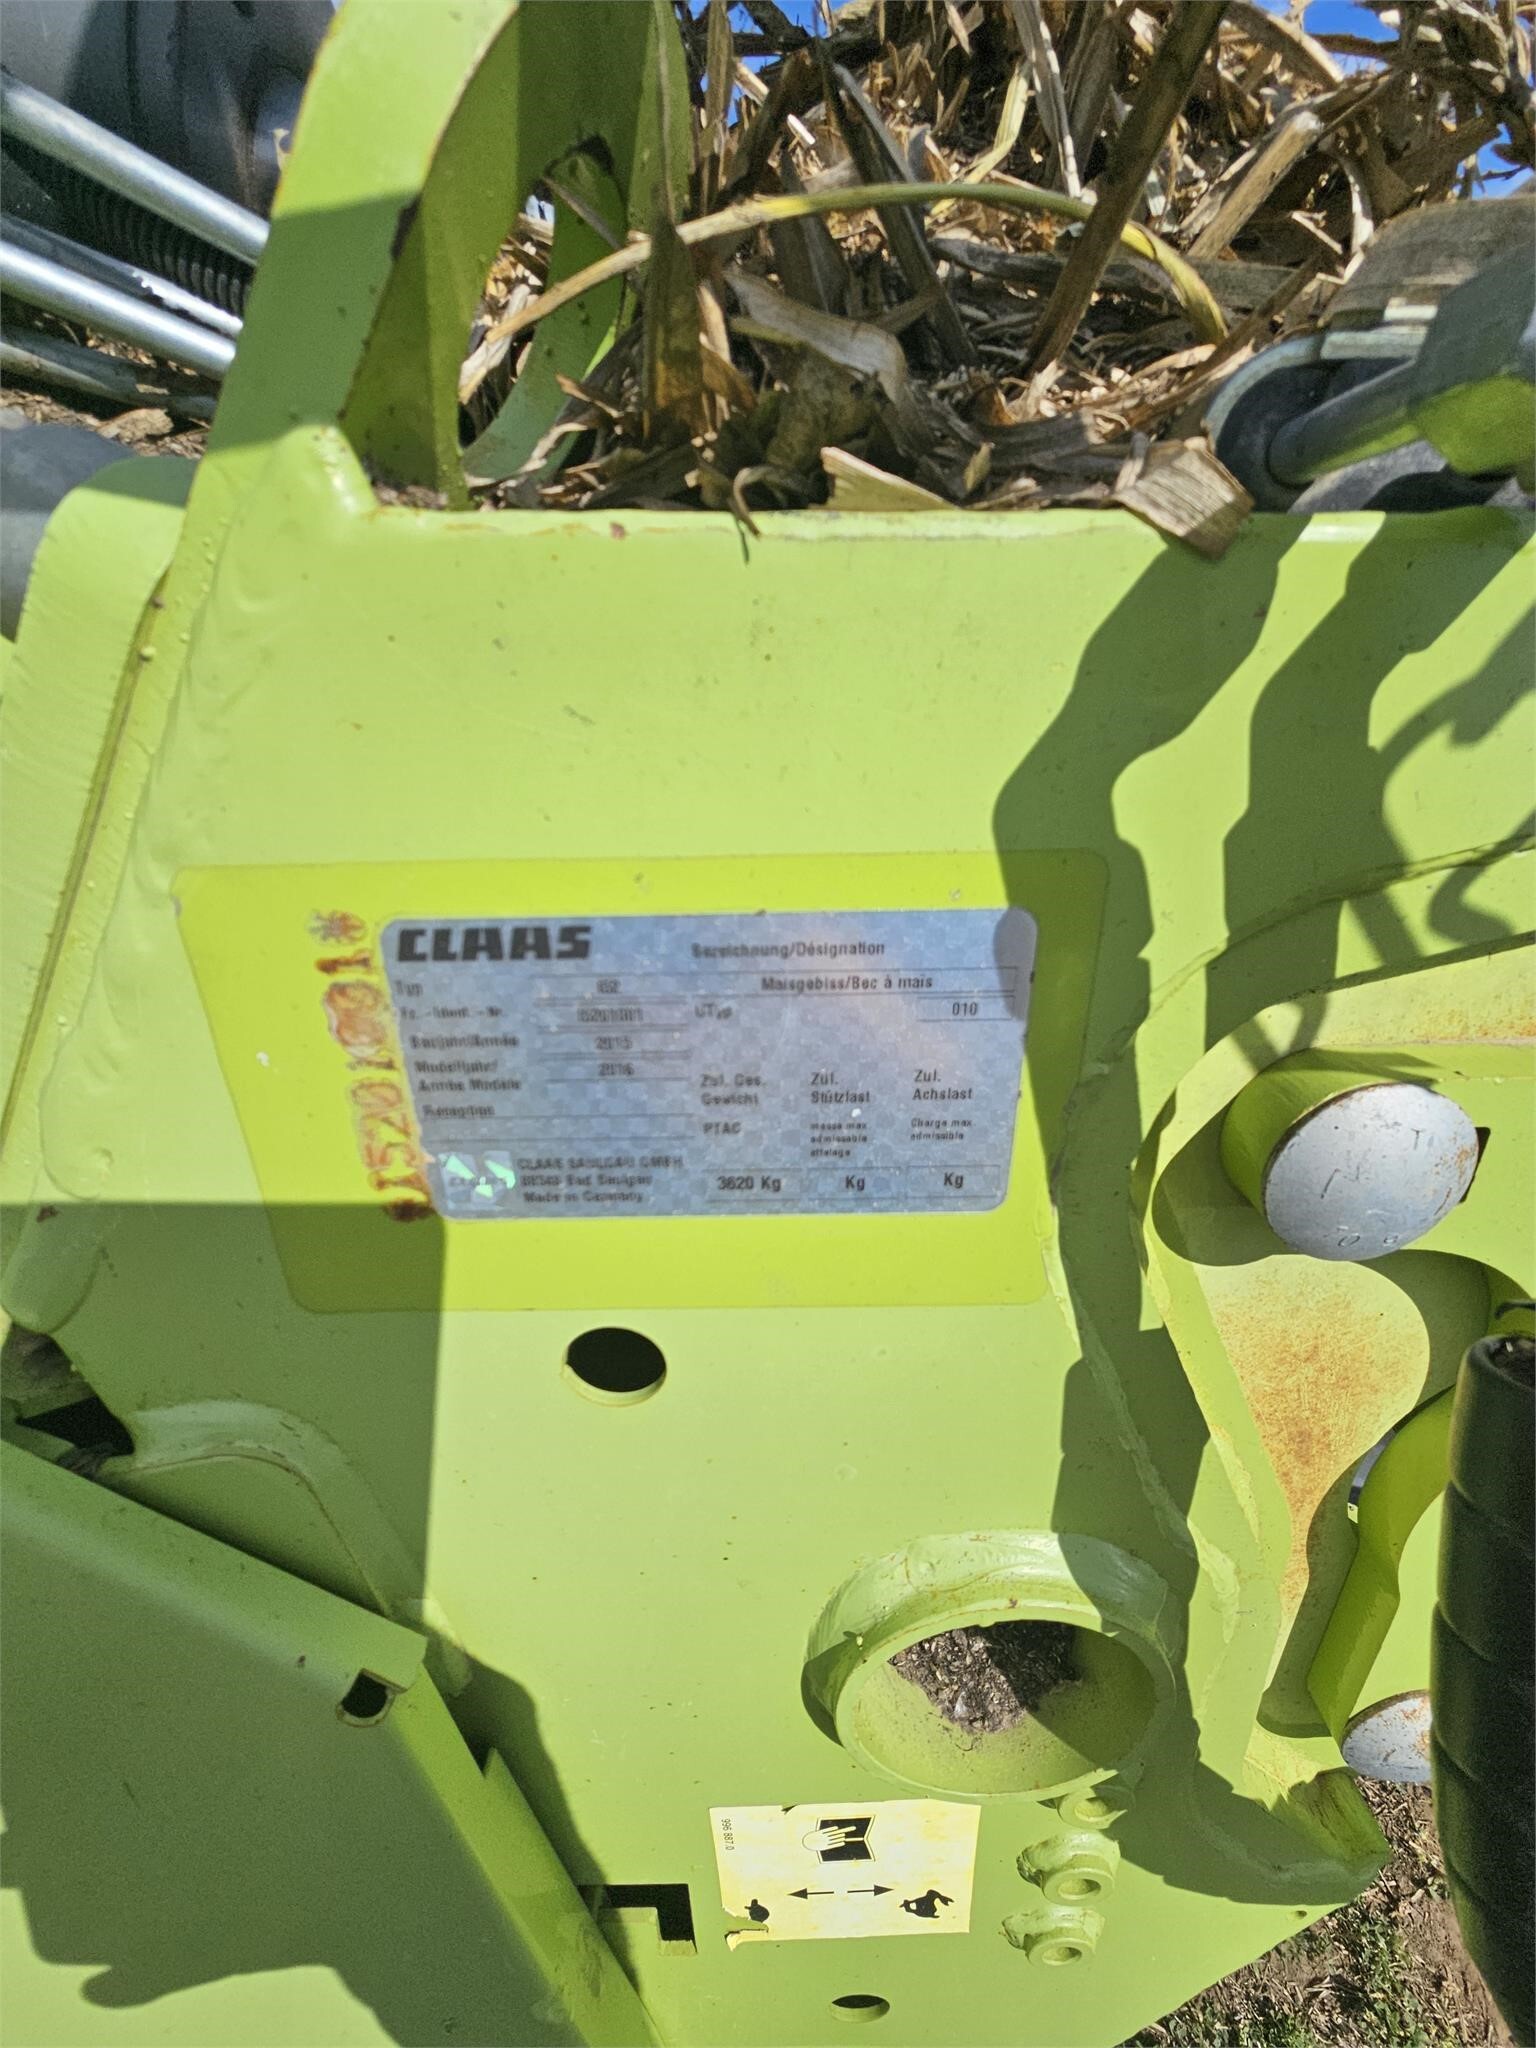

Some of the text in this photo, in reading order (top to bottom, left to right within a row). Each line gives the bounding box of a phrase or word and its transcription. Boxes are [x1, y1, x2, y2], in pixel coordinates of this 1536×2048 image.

[397, 925, 592, 962] CLAAS
[761, 975, 878, 991] Maisgebiss/Bec
[951, 1002, 978, 1017] 010
[914, 1069, 942, 1083] Zul.
[912, 1086, 973, 1101] Achslast
[702, 1121, 741, 1135] PTAC
[760, 1175, 782, 1192] Kg
[845, 1174, 866, 1191] Kg
[943, 1171, 965, 1188] Kg
